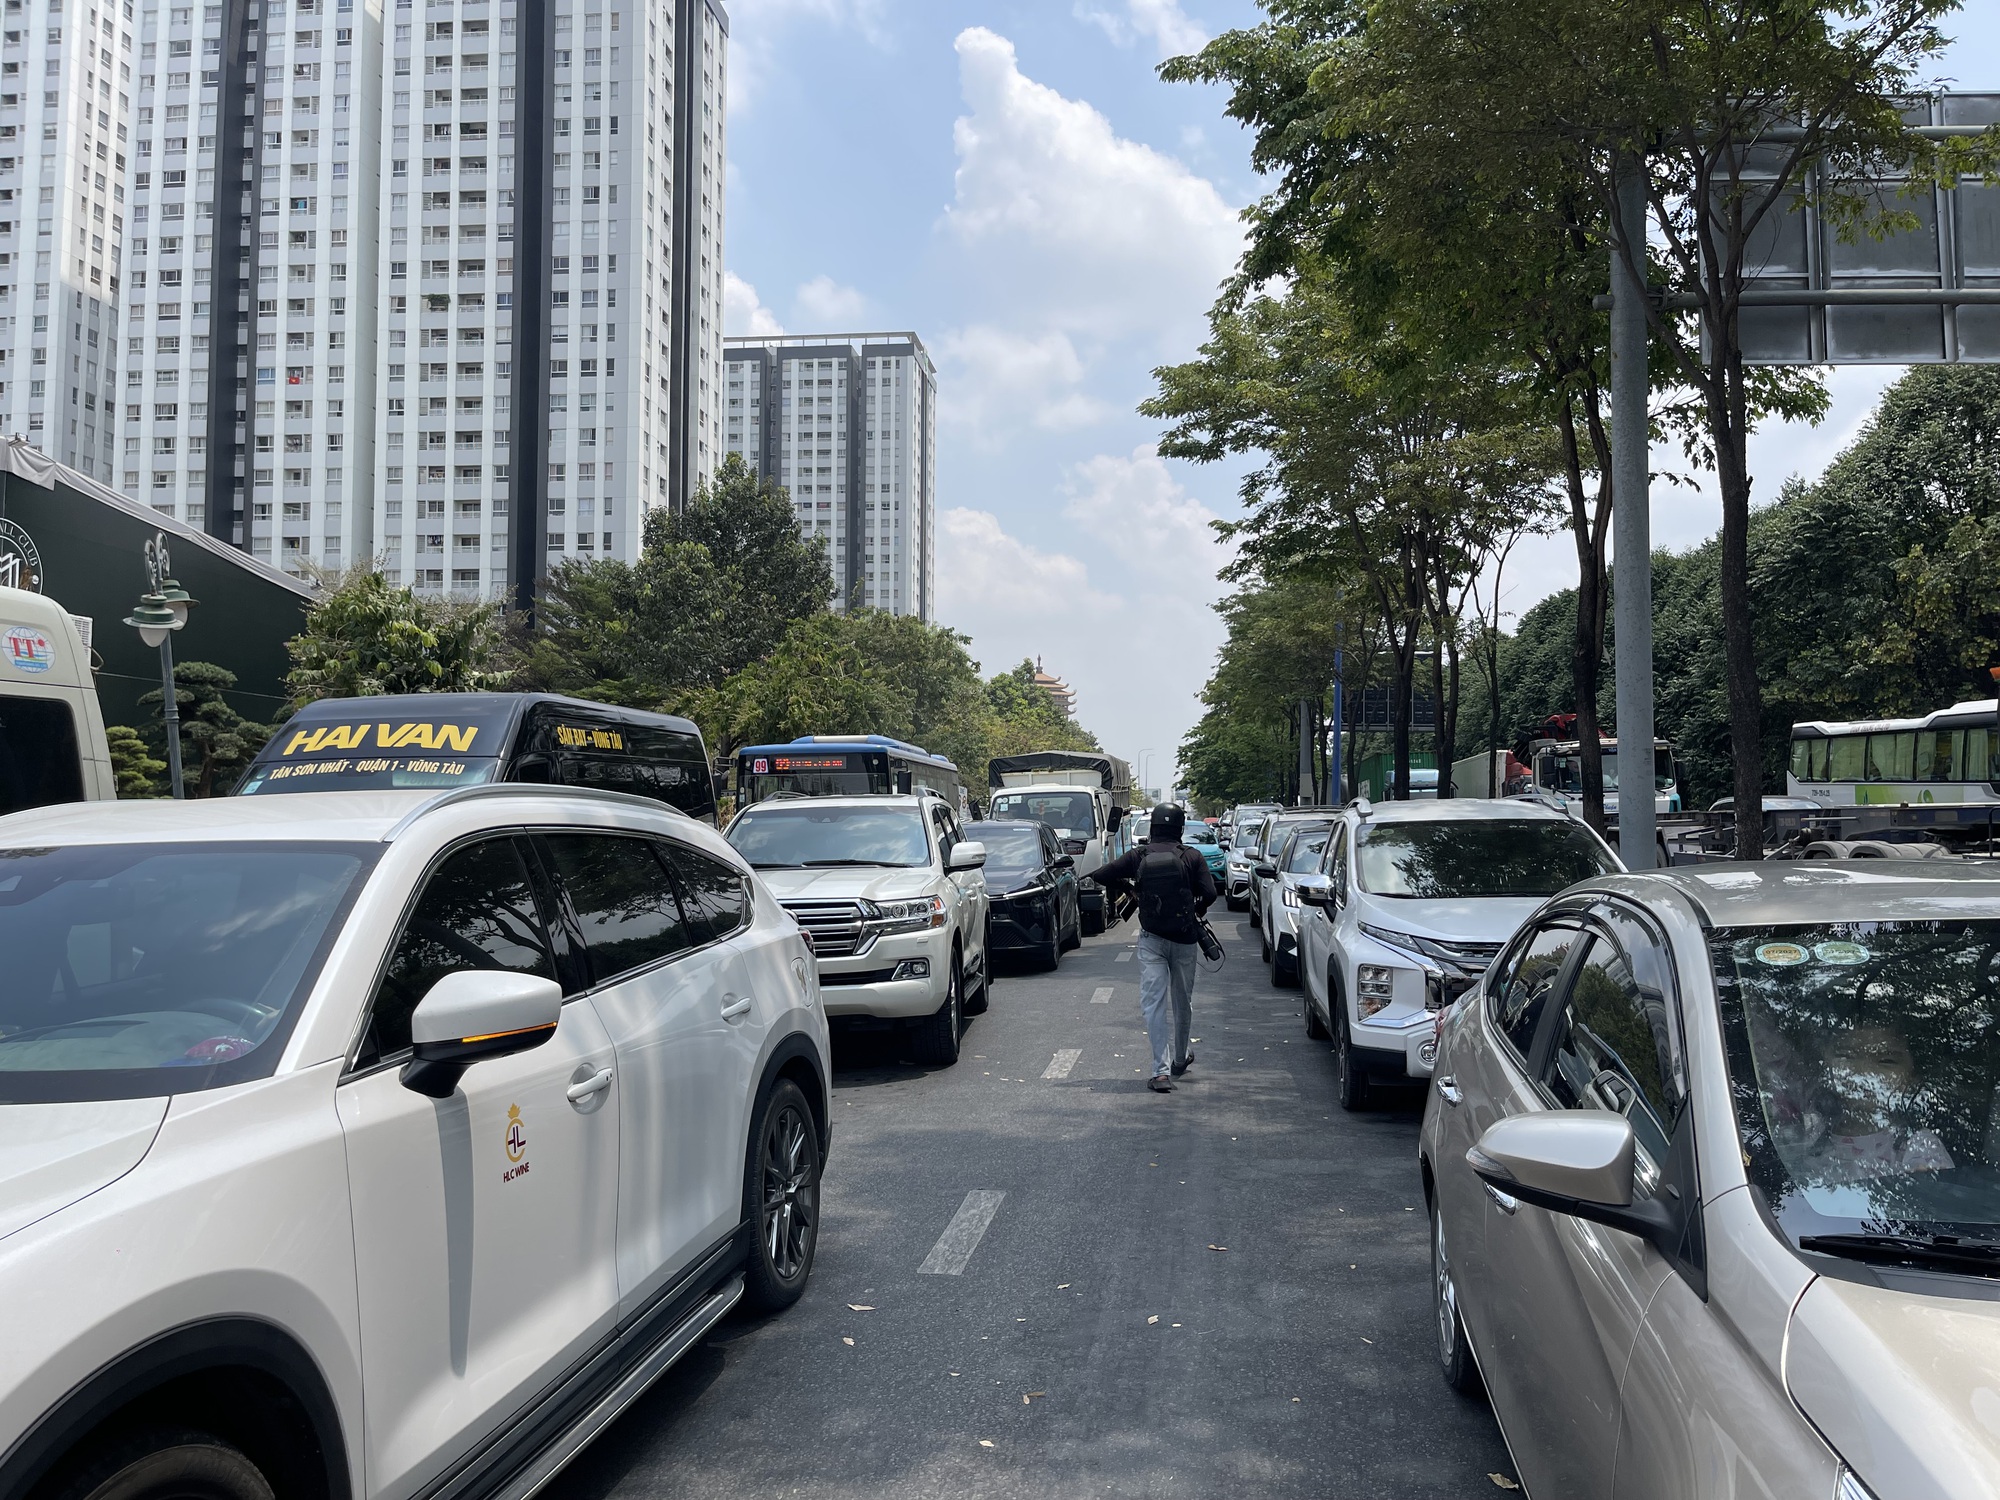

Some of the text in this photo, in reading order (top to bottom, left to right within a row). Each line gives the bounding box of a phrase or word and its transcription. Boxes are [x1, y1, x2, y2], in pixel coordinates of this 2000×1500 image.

[18, 534, 39, 567] CLUB
[282, 723, 479, 756] HAI VAN
[269, 765, 294, 780] TÂN
[291, 763, 319, 776] SƠN
[316, 758, 350, 773] NHẤT
[355, 758, 391, 773] QUẬN
[390, 760, 400, 771] 1
[406, 759, 440, 773] VŨNG
[440, 761, 466, 775] TÀU
[755, 760, 767, 772] 99
[503, 1162, 529, 1183] HLC WINE
